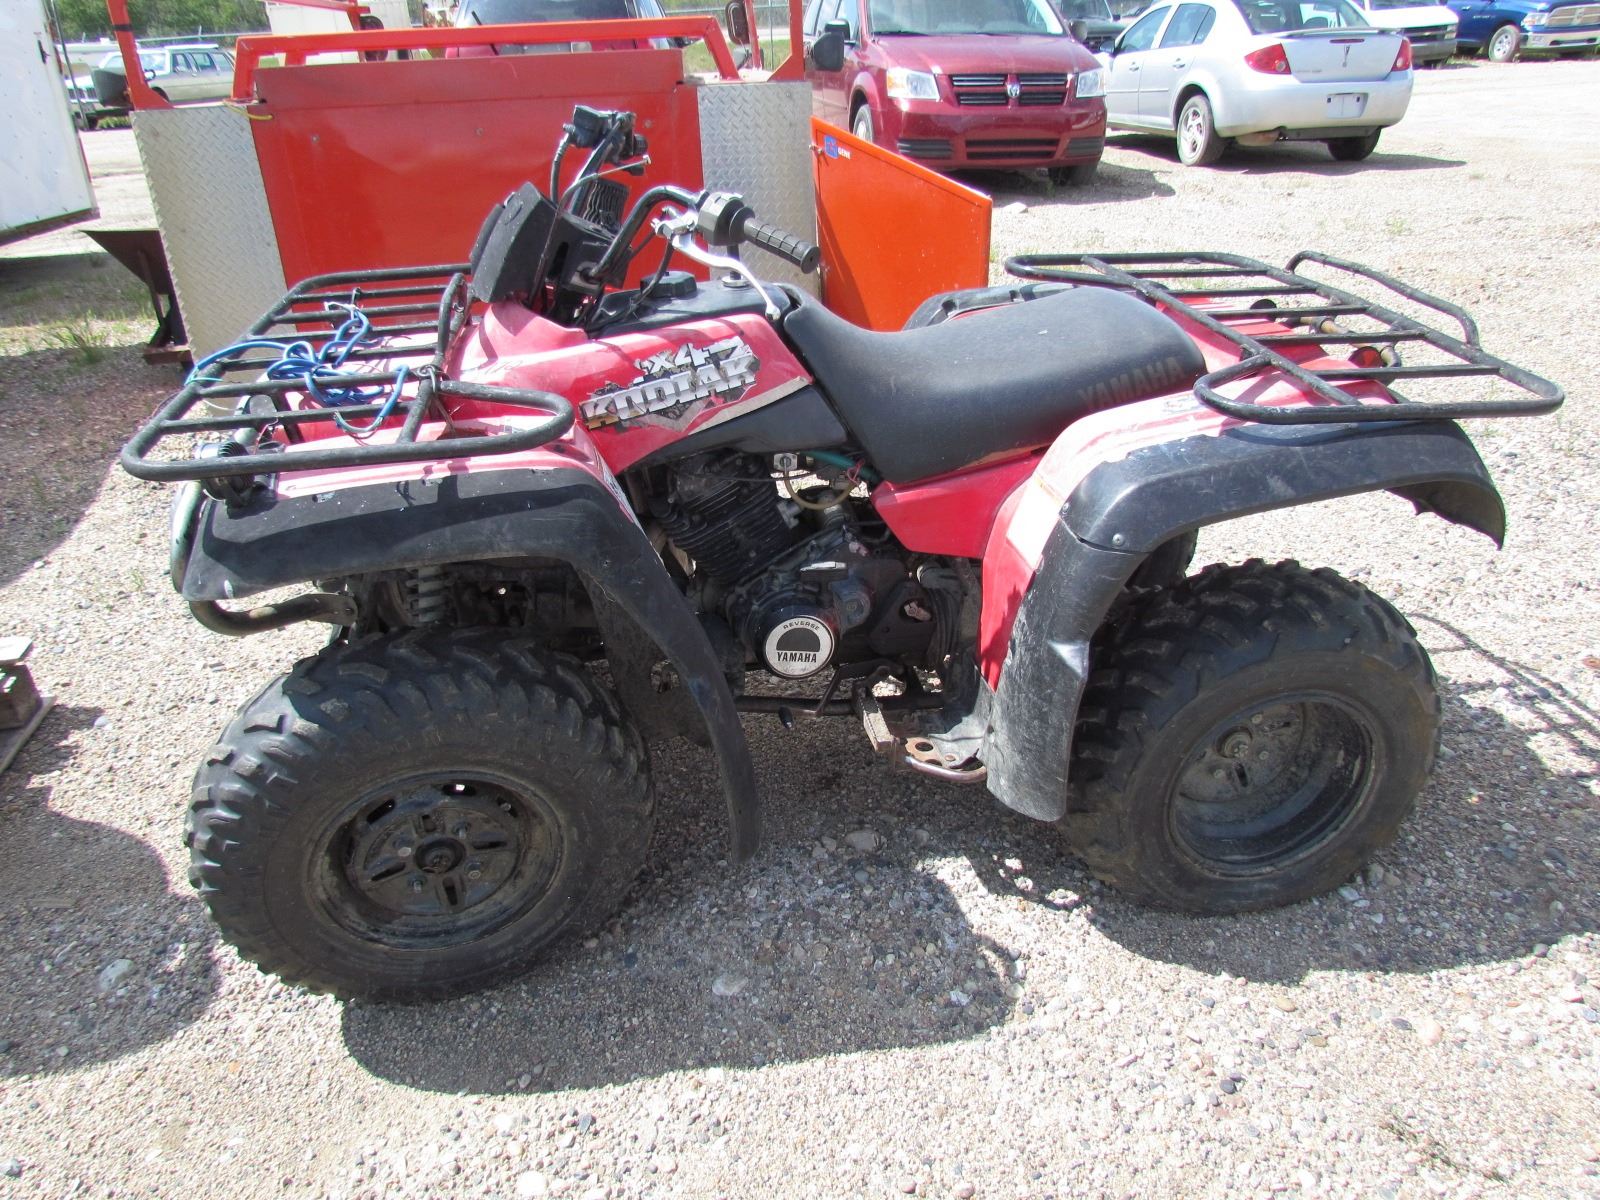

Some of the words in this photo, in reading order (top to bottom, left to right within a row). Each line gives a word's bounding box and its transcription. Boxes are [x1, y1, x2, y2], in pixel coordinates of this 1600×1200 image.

[579, 353, 757, 430] KODIAK
[1077, 356, 1185, 409] YAMAHA
[784, 621, 819, 630] REVERSE
[778, 652, 817, 662] YAMAHA
